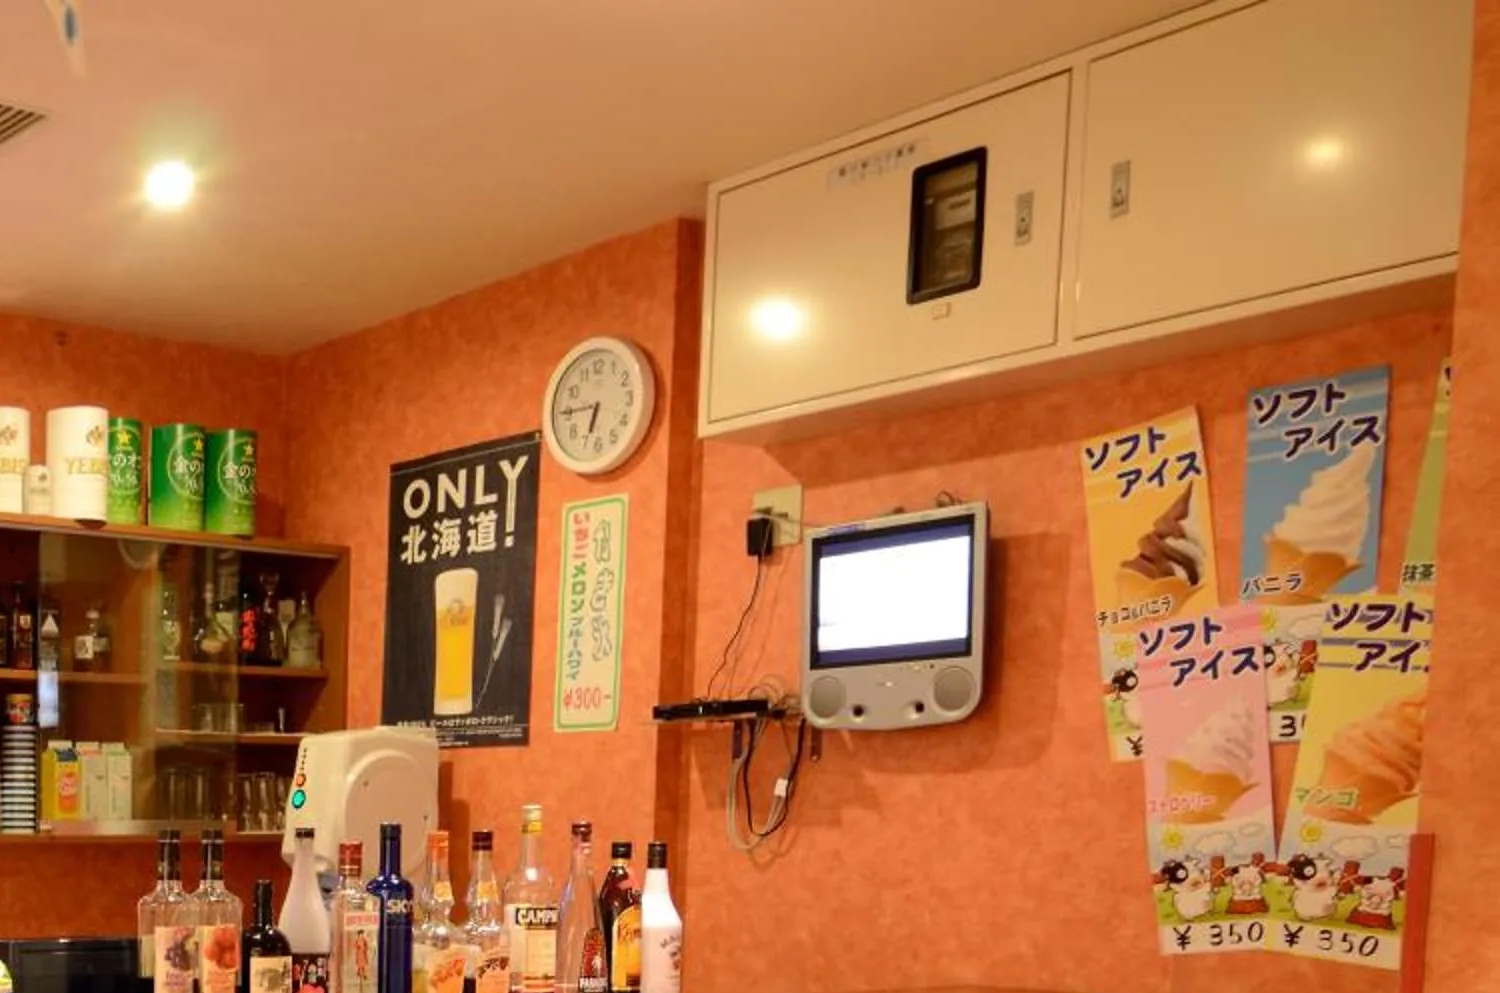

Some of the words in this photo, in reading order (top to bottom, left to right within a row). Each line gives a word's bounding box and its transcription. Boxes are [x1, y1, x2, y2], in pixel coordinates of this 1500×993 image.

[592, 359, 605, 375] 12
[621, 370, 629, 387] 2
[625, 390, 634, 407] 3
[1254, 383, 1345, 424] ソフト
[593, 437, 603, 453] 6
[609, 429, 619, 445] 5
[1085, 427, 1166, 471] ソフト
[1284, 416, 1380, 458] アイス
[1117, 451, 1201, 498] アイス
[1243, 574, 1302, 594] バニラ
[1331, 602, 1425, 633] ソフト
[1139, 616, 1222, 656] ソフト
[1169, 645, 1259, 687] アイス
[1356, 641, 1430, 673] アイ
[1279, 715, 1307, 737] 3
